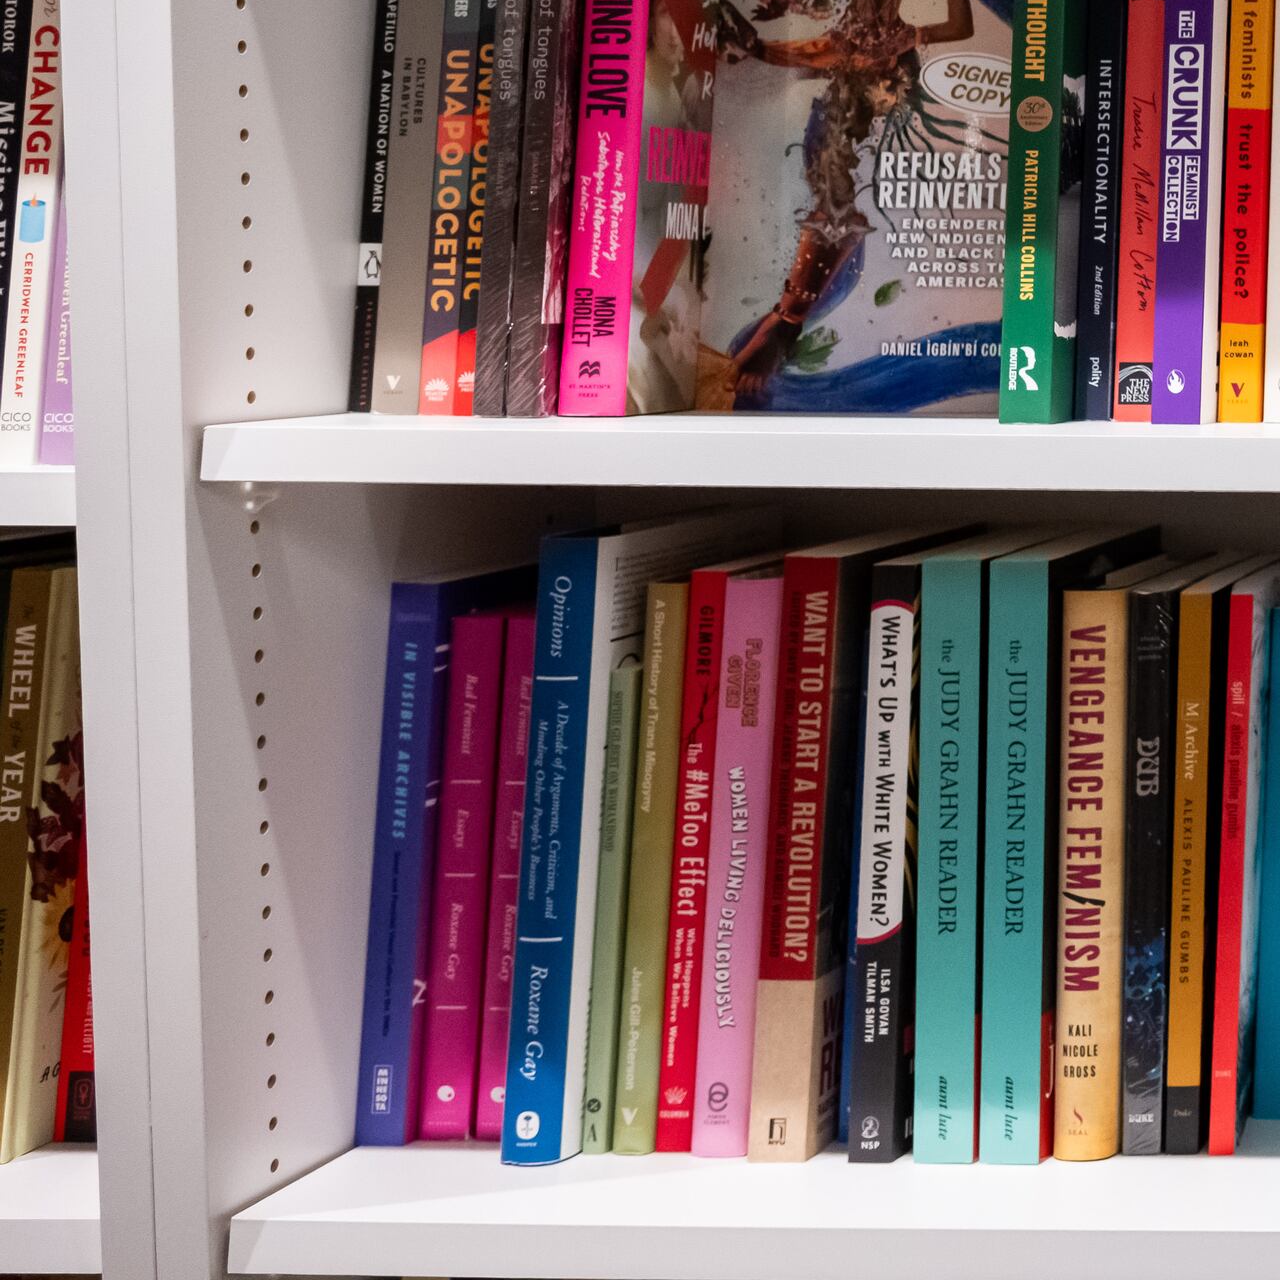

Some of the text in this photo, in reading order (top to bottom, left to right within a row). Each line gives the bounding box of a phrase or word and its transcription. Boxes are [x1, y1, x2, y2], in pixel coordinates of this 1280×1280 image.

[585, 53, 629, 120] LOVE
[1170, 46, 1200, 147] CRUNK
[1093, 59, 1113, 245] INTERSECTIONALITY
[1019, 150, 1039, 301] PATRICIA HILL COLLINS
[571, 287, 595, 347] CHOLLET
[592, 296, 617, 337] MONA
[1088, 356, 1102, 388] polity
[547, 574, 572, 658] Opinions
[1003, 639, 1027, 937] the JUDY GRAHN READER
[519, 965, 549, 1081] Roxane Gay
